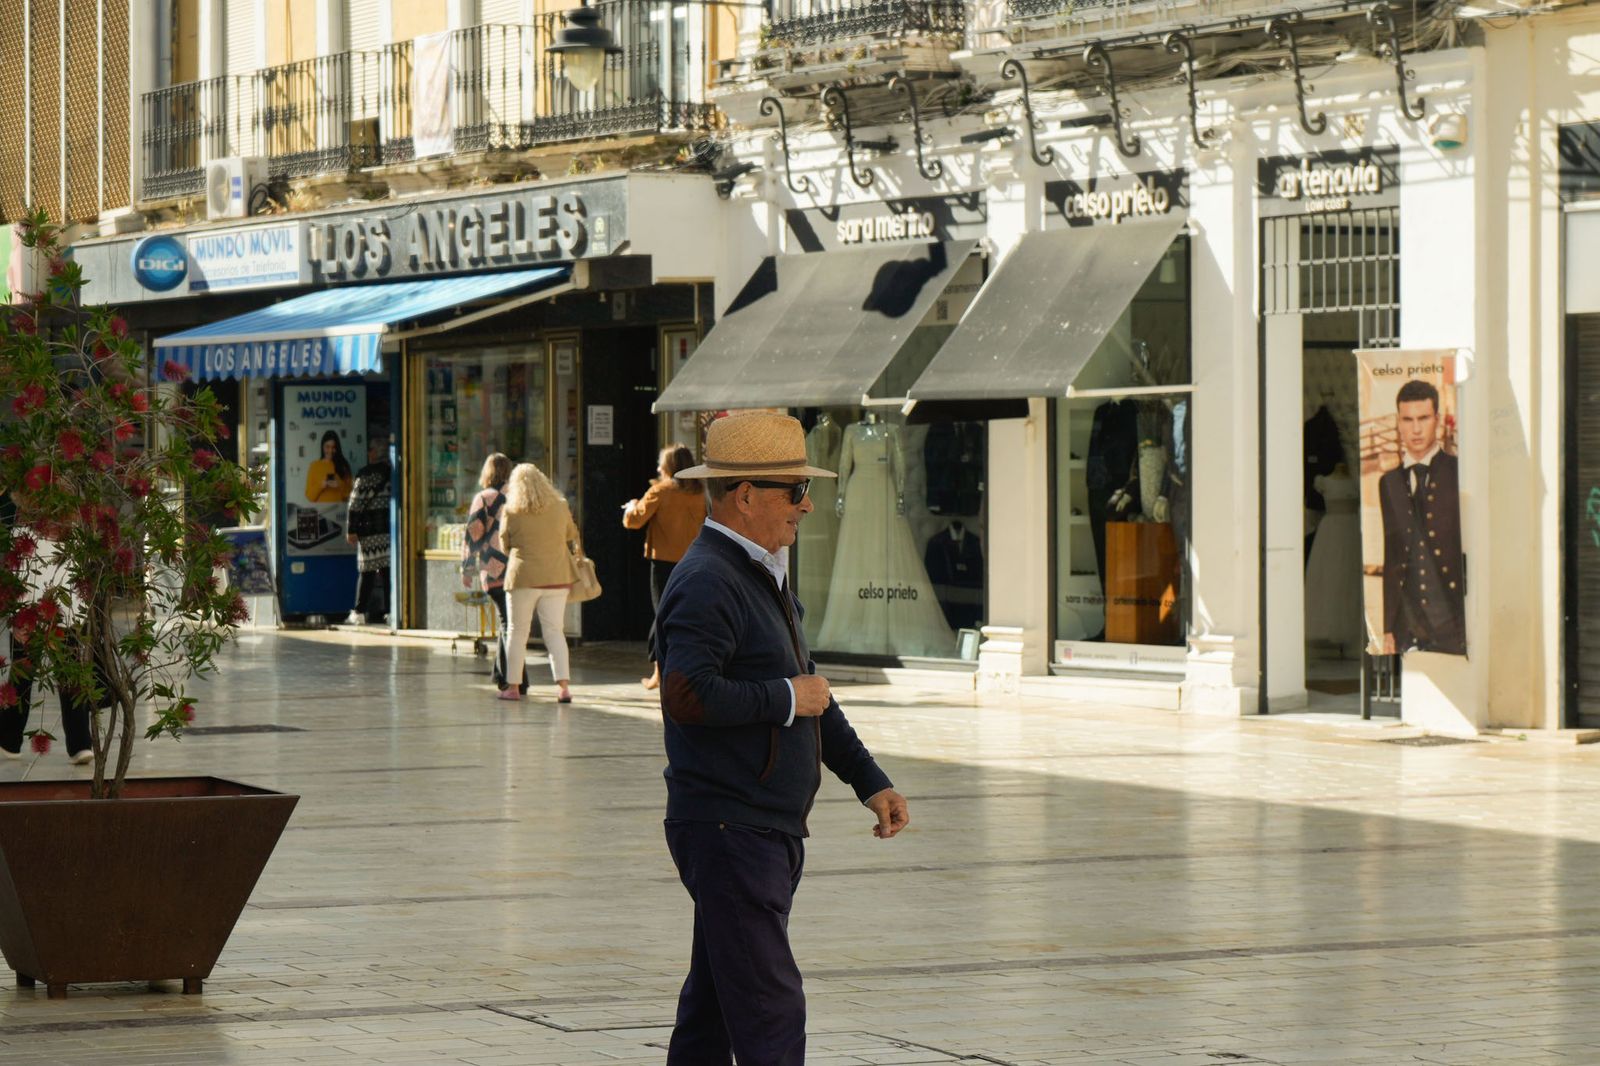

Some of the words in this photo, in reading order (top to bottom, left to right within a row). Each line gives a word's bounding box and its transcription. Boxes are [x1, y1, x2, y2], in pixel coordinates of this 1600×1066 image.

[1280, 158, 1380, 198] artenovia
[1064, 183, 1109, 219] celso
[1111, 176, 1169, 224] prieto
[1305, 200, 1324, 213] LOW
[1325, 197, 1348, 211] COST
[321, 218, 388, 275] LOS
[408, 193, 584, 266] ANGELES
[837, 218, 874, 242] sara
[875, 206, 935, 239] merino
[139, 257, 184, 271] DIGI
[205, 347, 235, 372] LOS
[242, 342, 322, 370] ANGELES
[1372, 363, 1403, 376] celso
[1407, 362, 1444, 378] prieto
[297, 390, 356, 403] MUNDO
[858, 581, 884, 599] celso
[887, 582, 918, 604] prieto
